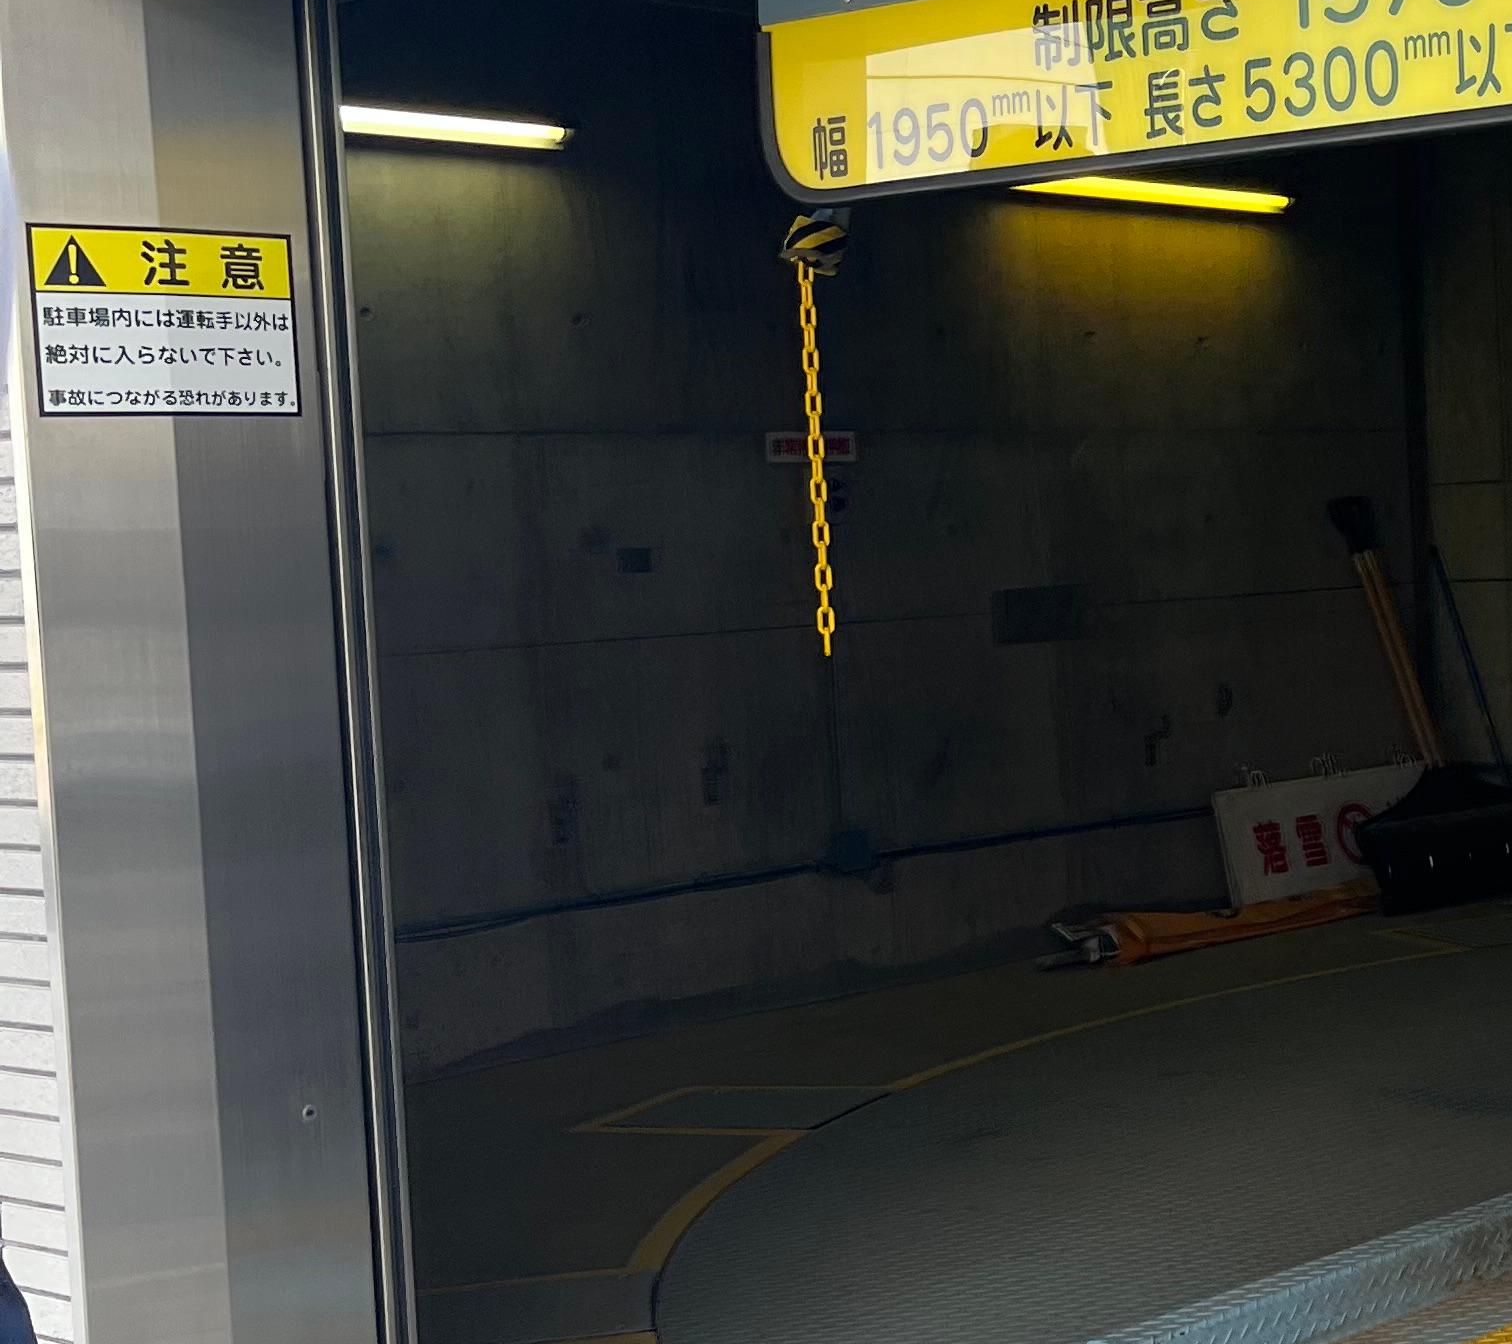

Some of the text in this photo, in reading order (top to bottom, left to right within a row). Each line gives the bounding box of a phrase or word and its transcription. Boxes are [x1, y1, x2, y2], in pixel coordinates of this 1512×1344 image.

[140, 238, 265, 291] 注意
[42, 306, 289, 332] 駐車場内には運転手以外は
[45, 344, 282, 368] 絶対に入らないで下さい。
[48, 389, 297, 407] 事故につながる恐れがあります。
